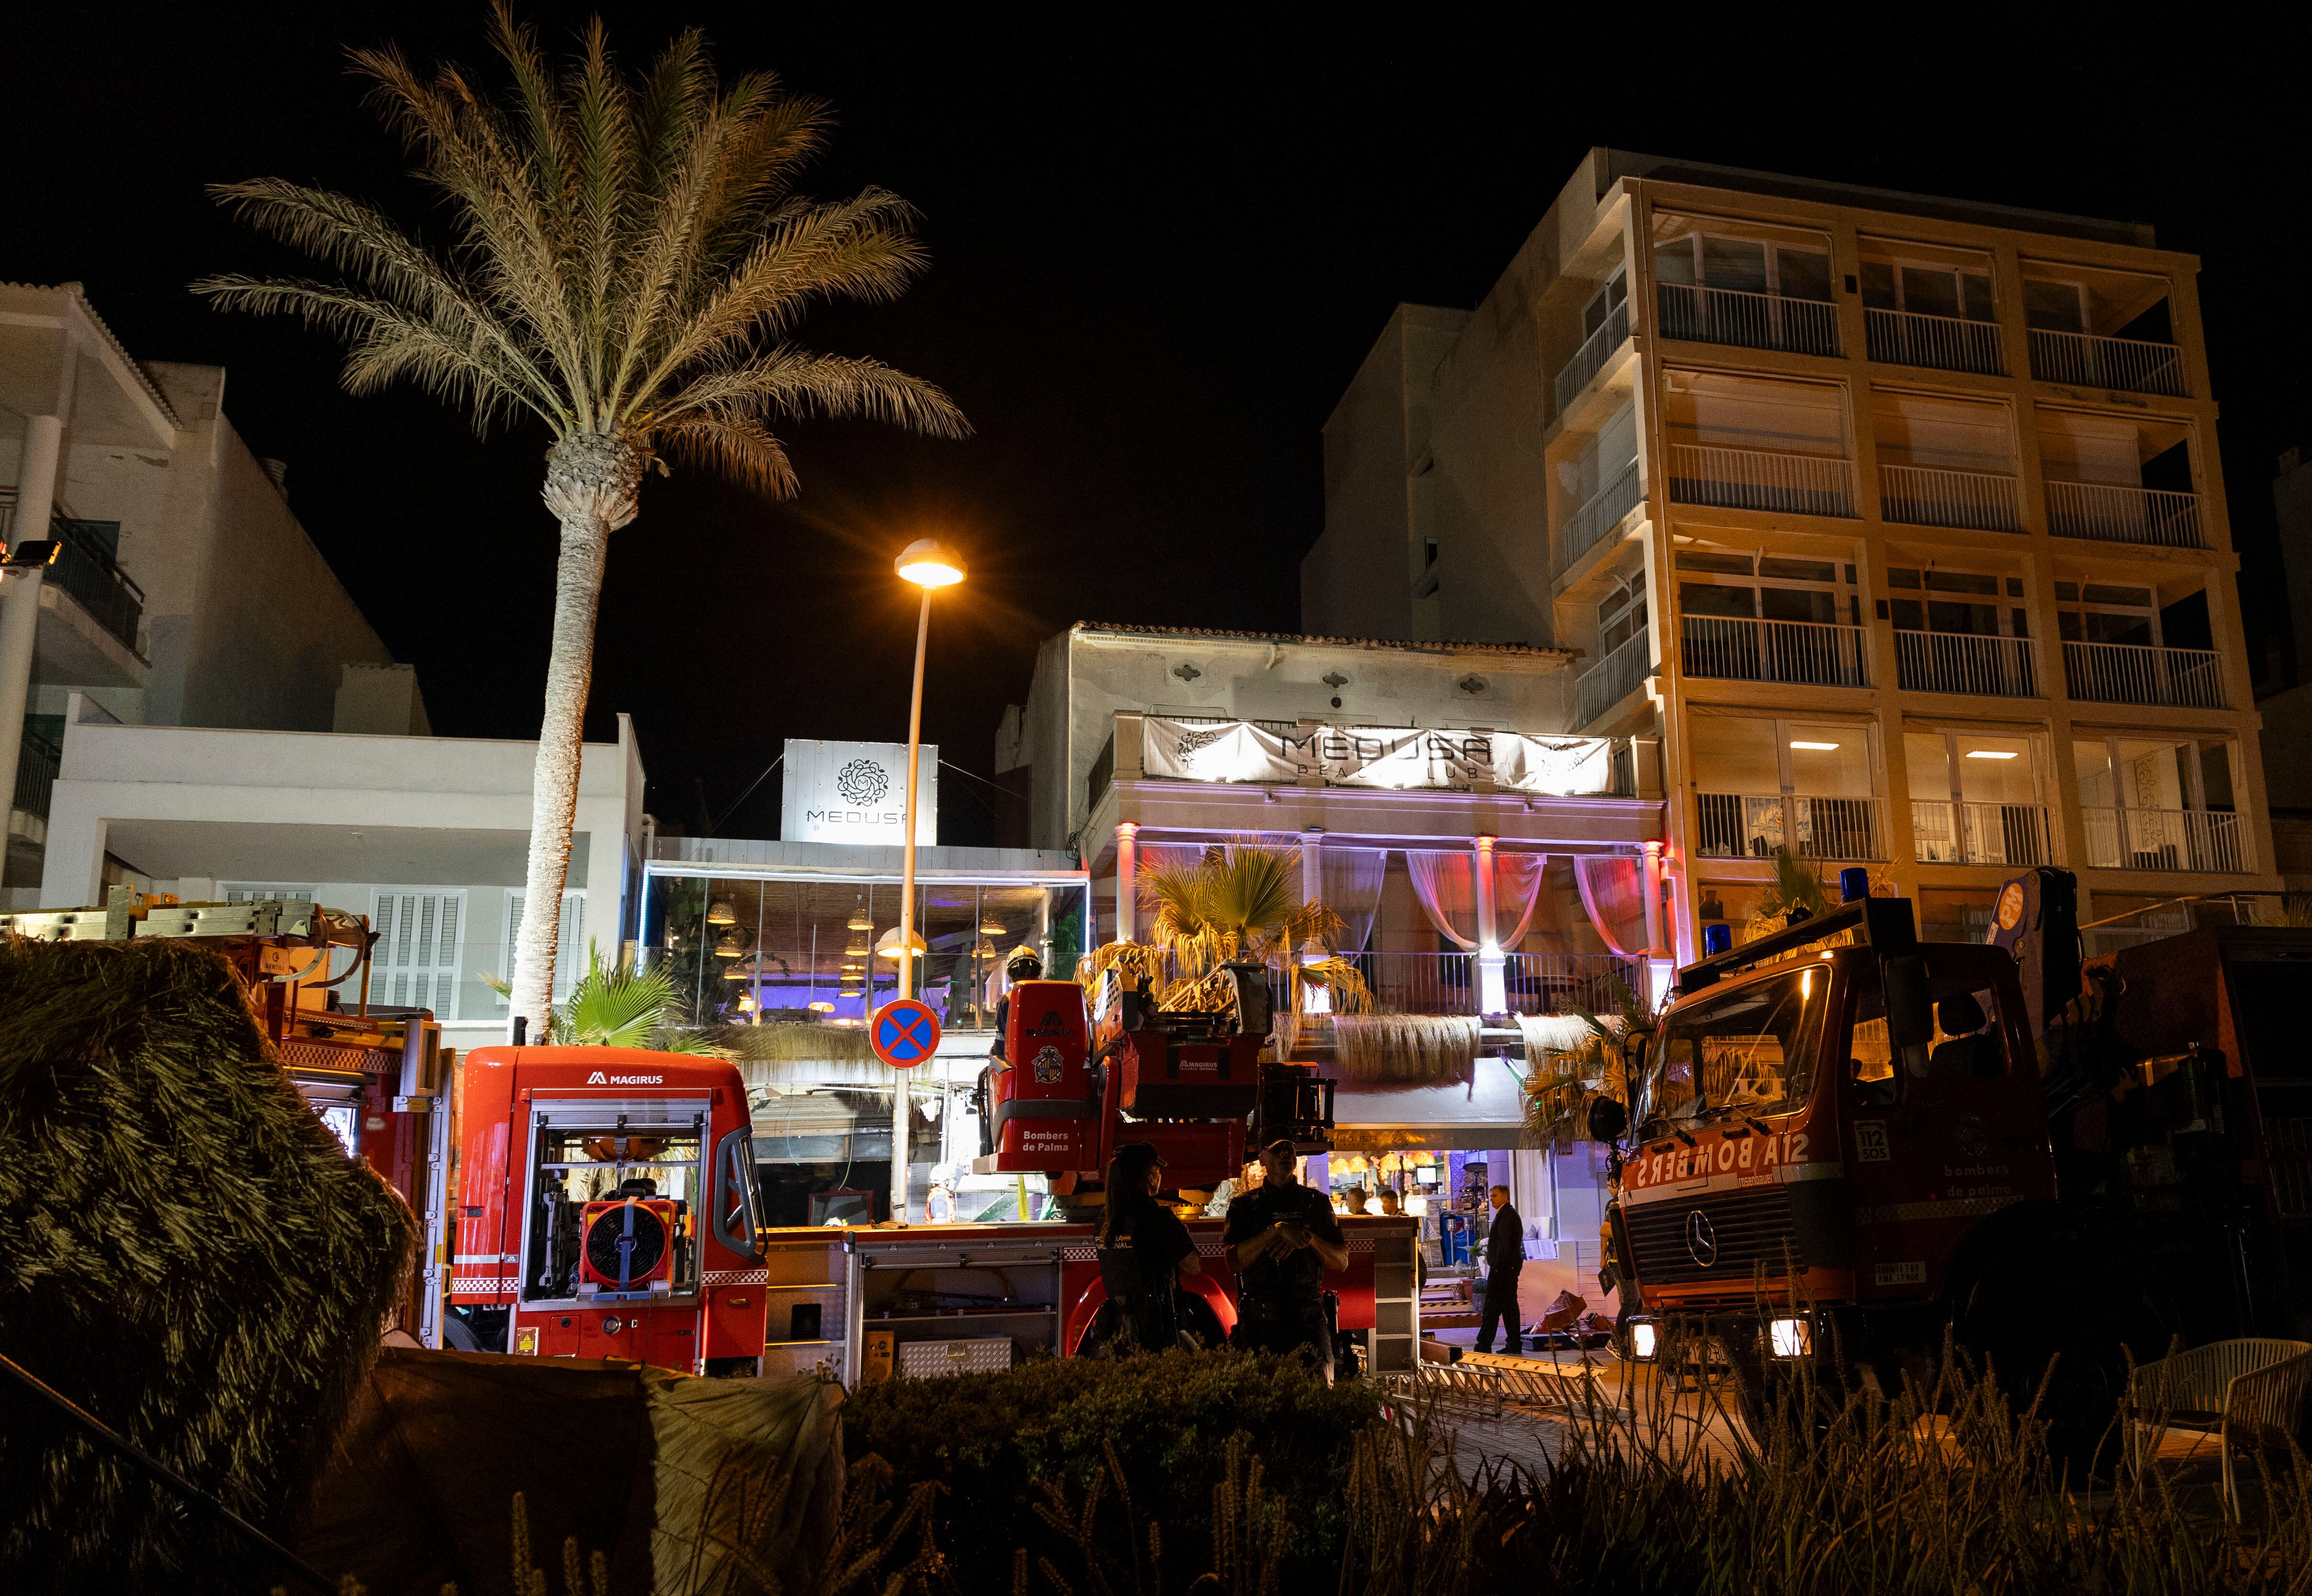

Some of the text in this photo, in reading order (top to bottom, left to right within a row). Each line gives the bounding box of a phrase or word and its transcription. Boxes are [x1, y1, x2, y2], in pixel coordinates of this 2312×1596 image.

[1282, 733, 1491, 763] MEDUSA
[1297, 764, 1478, 780] BEAC LUB
[2000, 886, 2023, 928] PM
[610, 1075, 663, 1084] MAGIRUS
[1023, 1131, 1068, 1140] Bombers
[1857, 1129, 1883, 1147] 112
[1022, 1143, 1068, 1151] de Palma
[1863, 1149, 1887, 1160] SOS
[1944, 1164, 2009, 1176] bombers
[1738, 1171, 1774, 1187] rosenbauer
[1947, 1183, 2012, 1199] de palma
